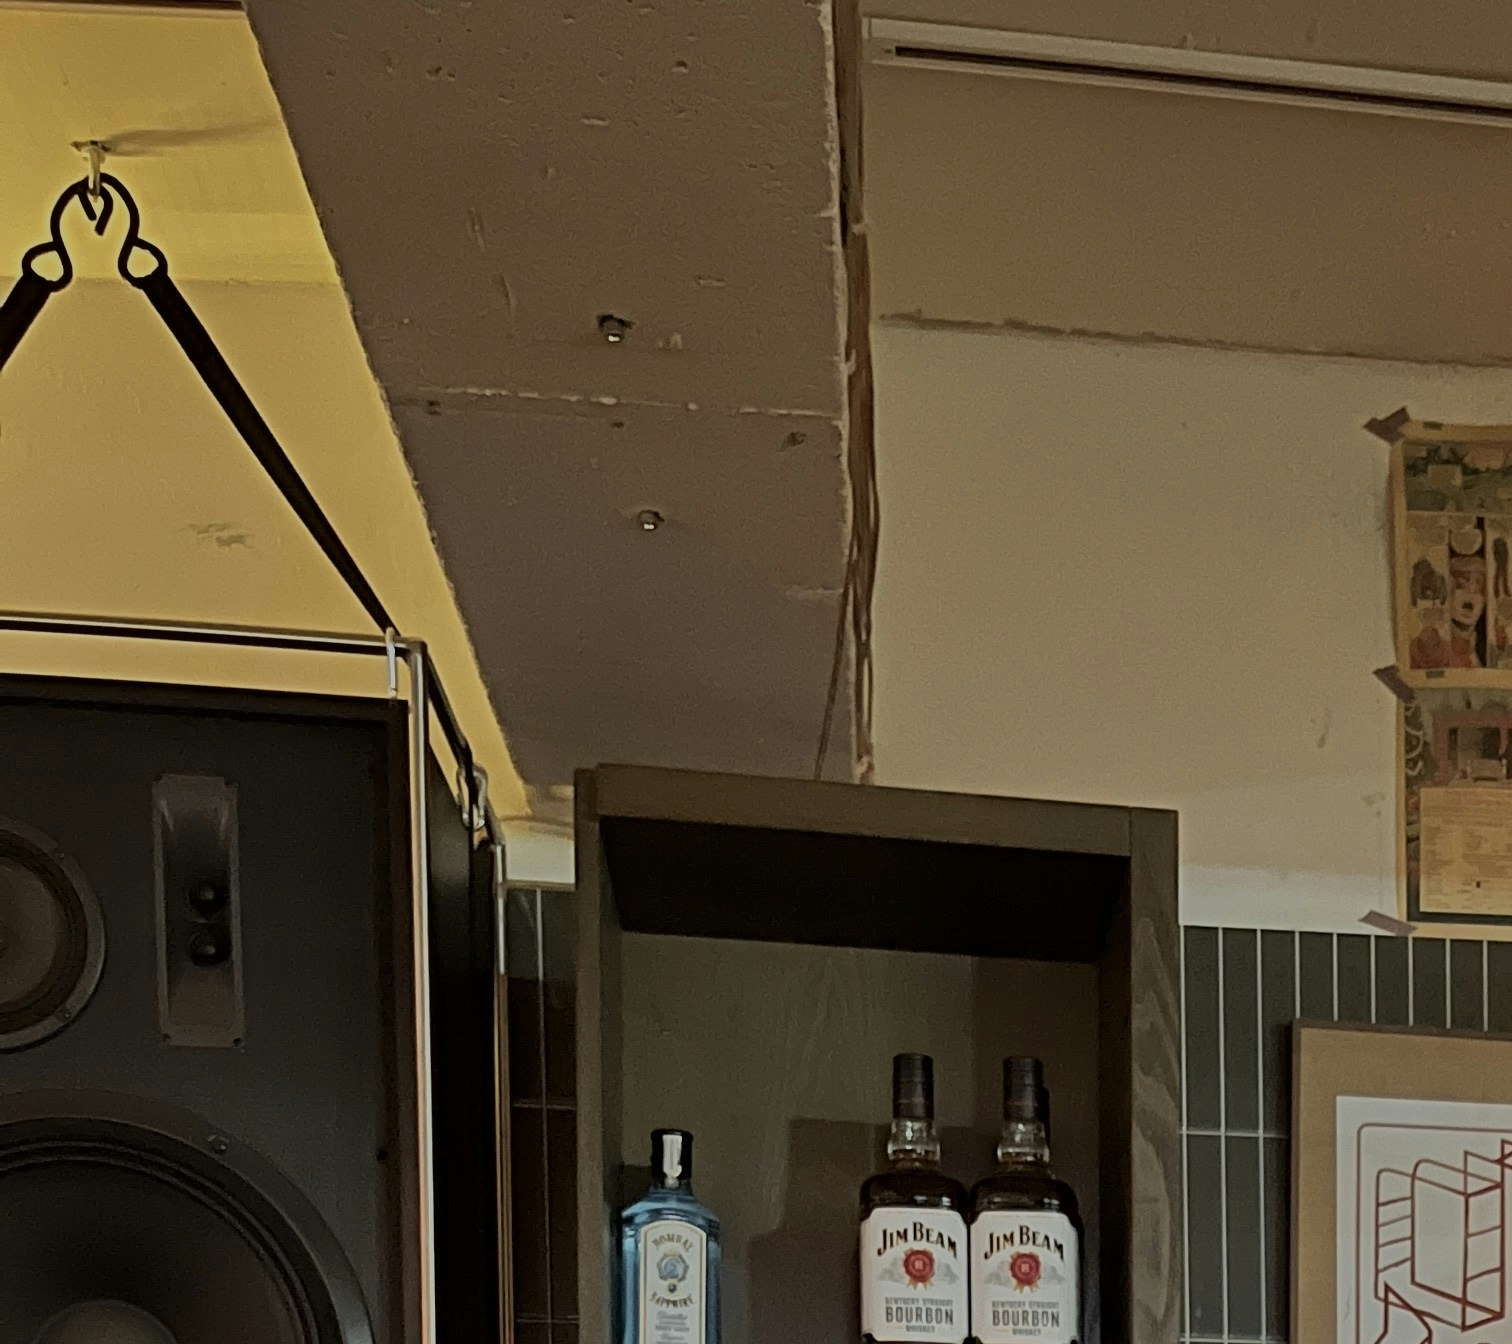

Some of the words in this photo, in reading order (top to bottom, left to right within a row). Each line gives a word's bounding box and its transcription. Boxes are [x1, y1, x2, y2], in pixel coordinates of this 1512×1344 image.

[912, 1221, 958, 1261] BEAM
[1019, 1225, 1065, 1262] BEAM
[885, 1306, 954, 1326] BOURBON
[992, 1309, 1060, 1328] BOURBON
